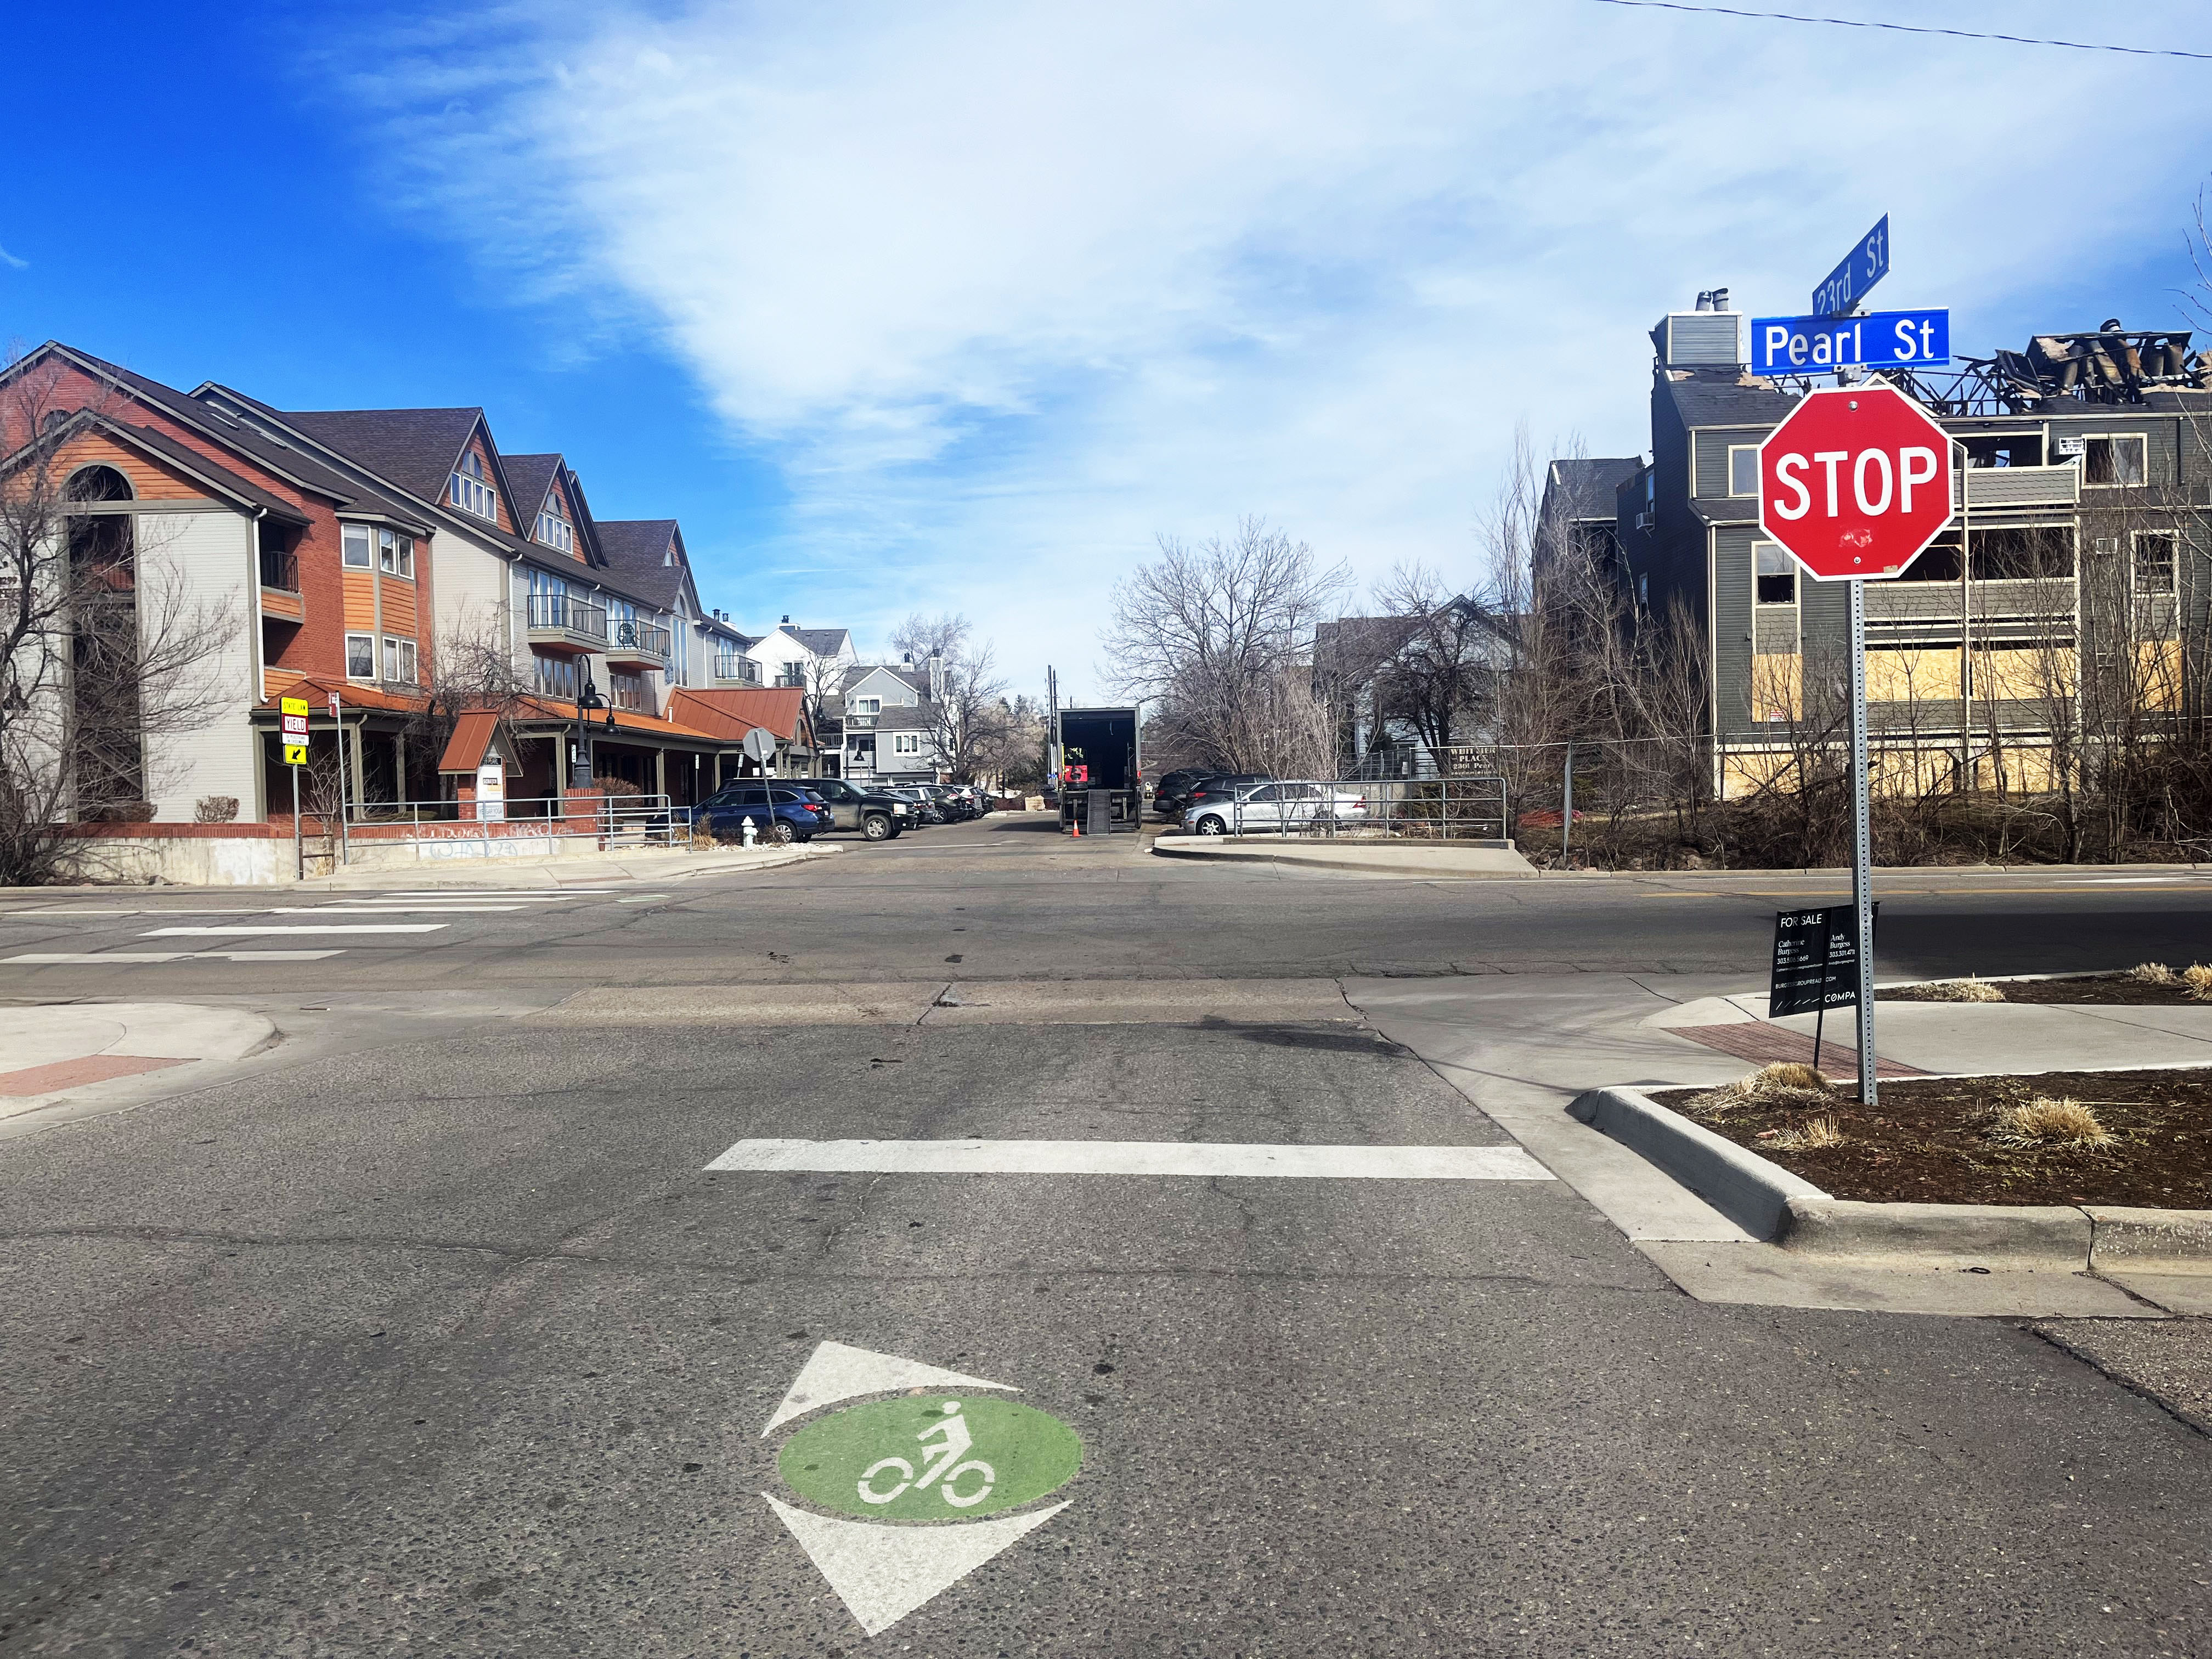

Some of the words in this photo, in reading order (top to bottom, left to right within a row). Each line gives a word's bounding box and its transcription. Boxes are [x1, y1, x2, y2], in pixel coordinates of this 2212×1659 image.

[1818, 261, 1851, 315] 23rd
[1866, 228, 1883, 278] St
[1765, 322, 1861, 367] Pearl
[1893, 319, 1935, 360] St
[1774, 447, 1938, 521] STOP
[284, 702, 296, 710] STATE
[286, 718, 305, 731] YIELD
[1781, 917, 1798, 928] FOR
[1801, 913, 1822, 926] SALE
[1830, 933, 1846, 941] Andy
